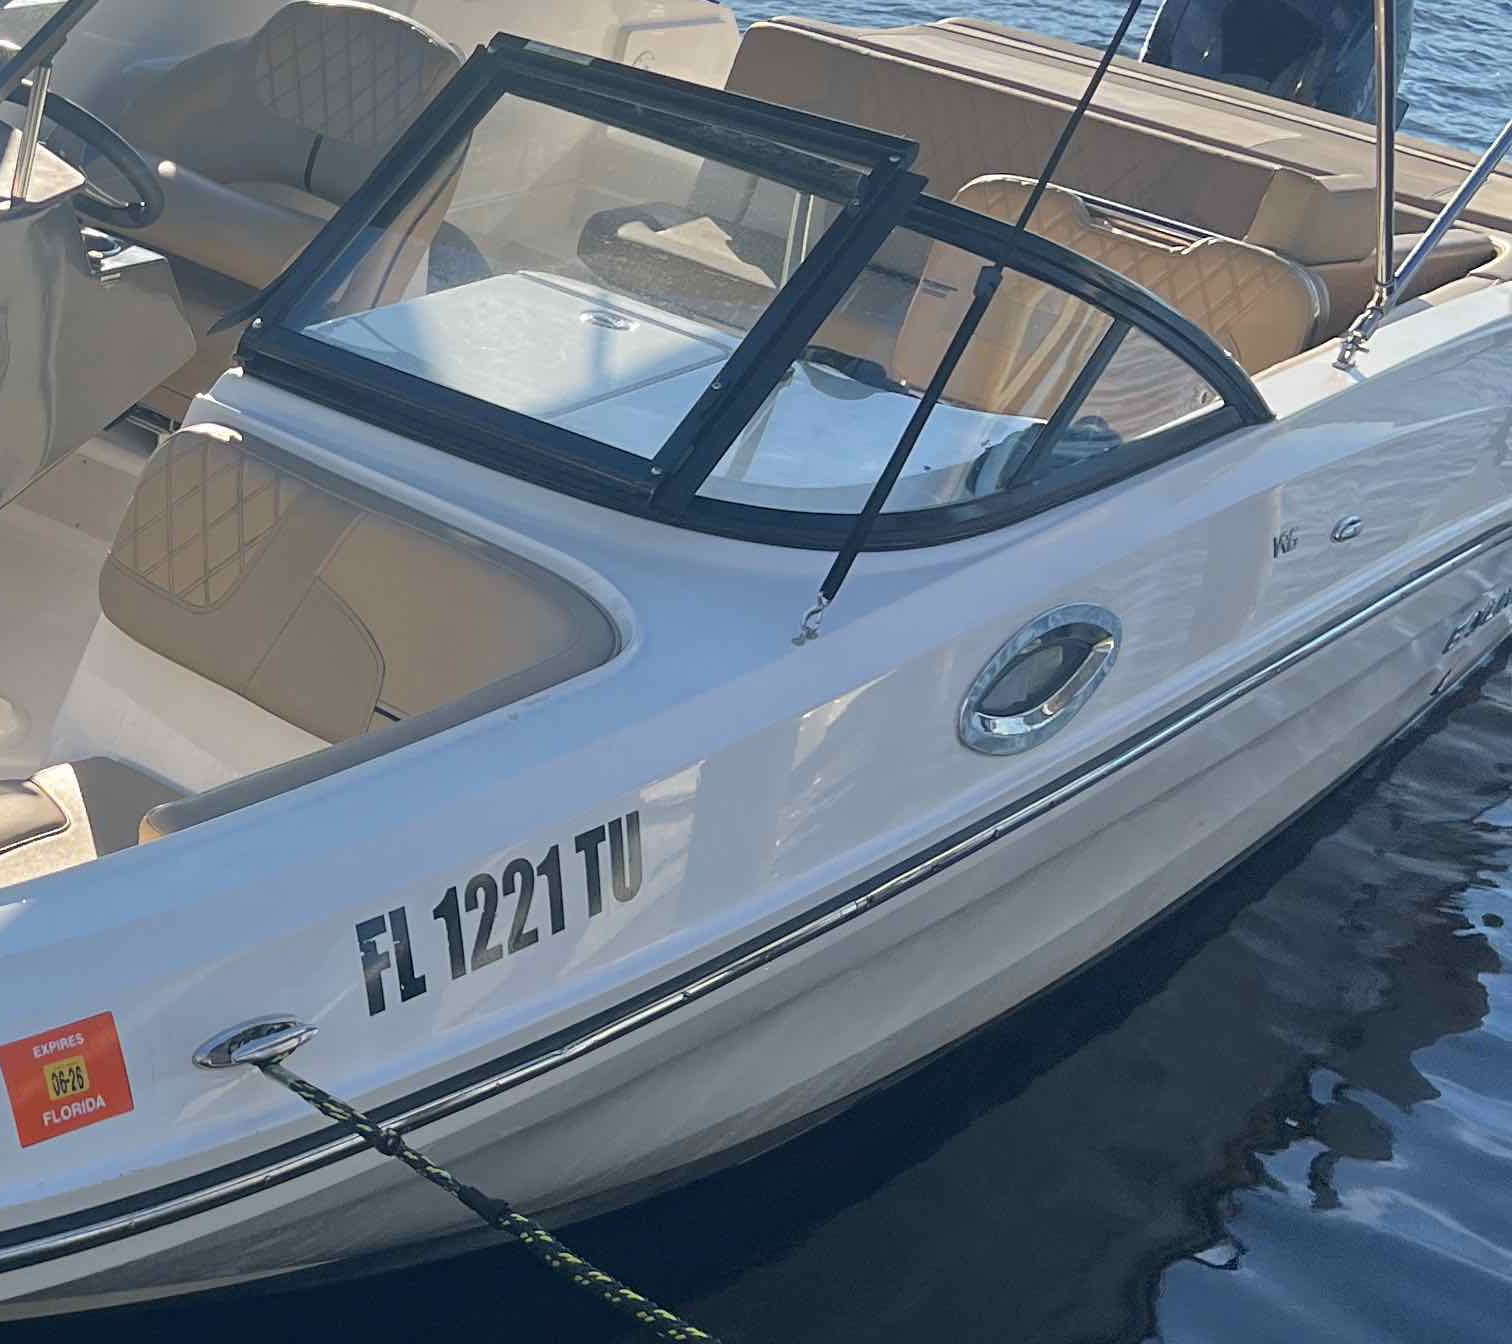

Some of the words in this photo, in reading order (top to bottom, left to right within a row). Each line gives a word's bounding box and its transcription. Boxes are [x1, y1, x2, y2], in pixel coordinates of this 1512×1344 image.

[355, 906, 427, 1016] FL
[432, 844, 566, 980] 1221
[574, 810, 643, 918] TU
[33, 1033, 85, 1058] EXPIRES
[51, 1066, 84, 1096] 06-26
[43, 1095, 106, 1126] FLORIDA
